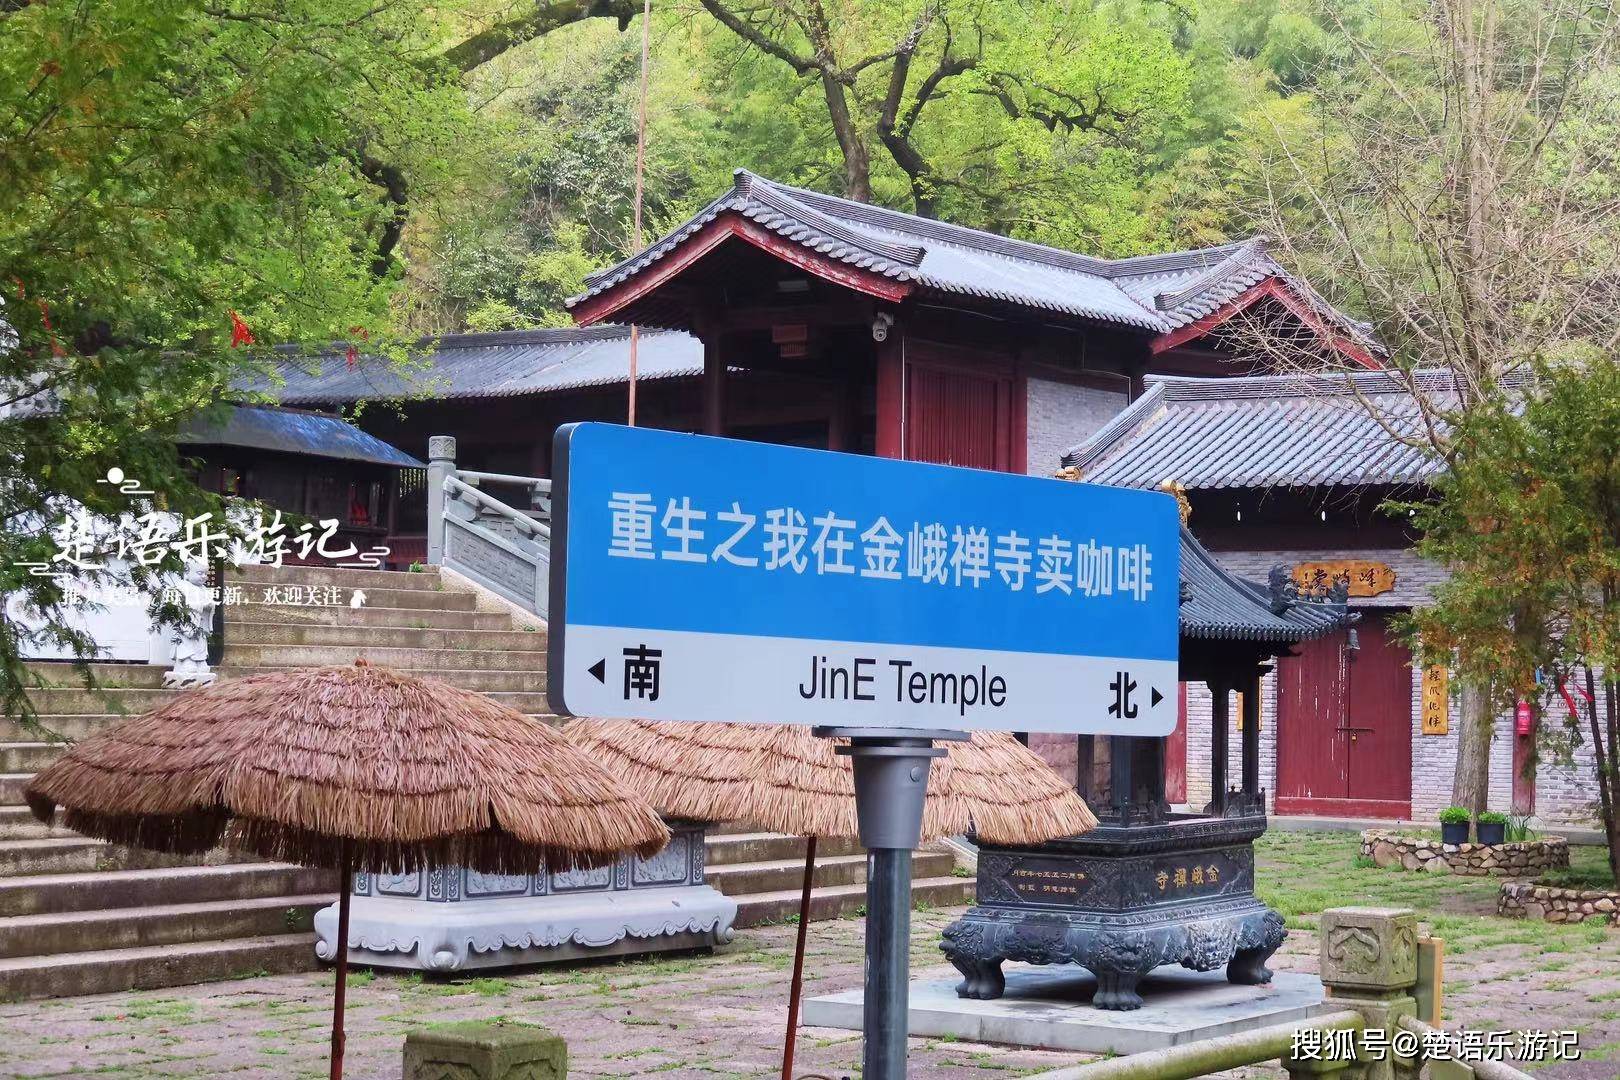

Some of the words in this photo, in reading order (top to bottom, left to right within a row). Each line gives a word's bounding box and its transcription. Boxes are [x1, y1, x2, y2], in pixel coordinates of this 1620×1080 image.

[607, 491, 1153, 602] 重生之我在金峨禅寺卖咖啡
[622, 644, 662, 701] 南
[799, 655, 876, 702] JinE
[889, 659, 1007, 716] Temple
[1107, 671, 1139, 719] 北
